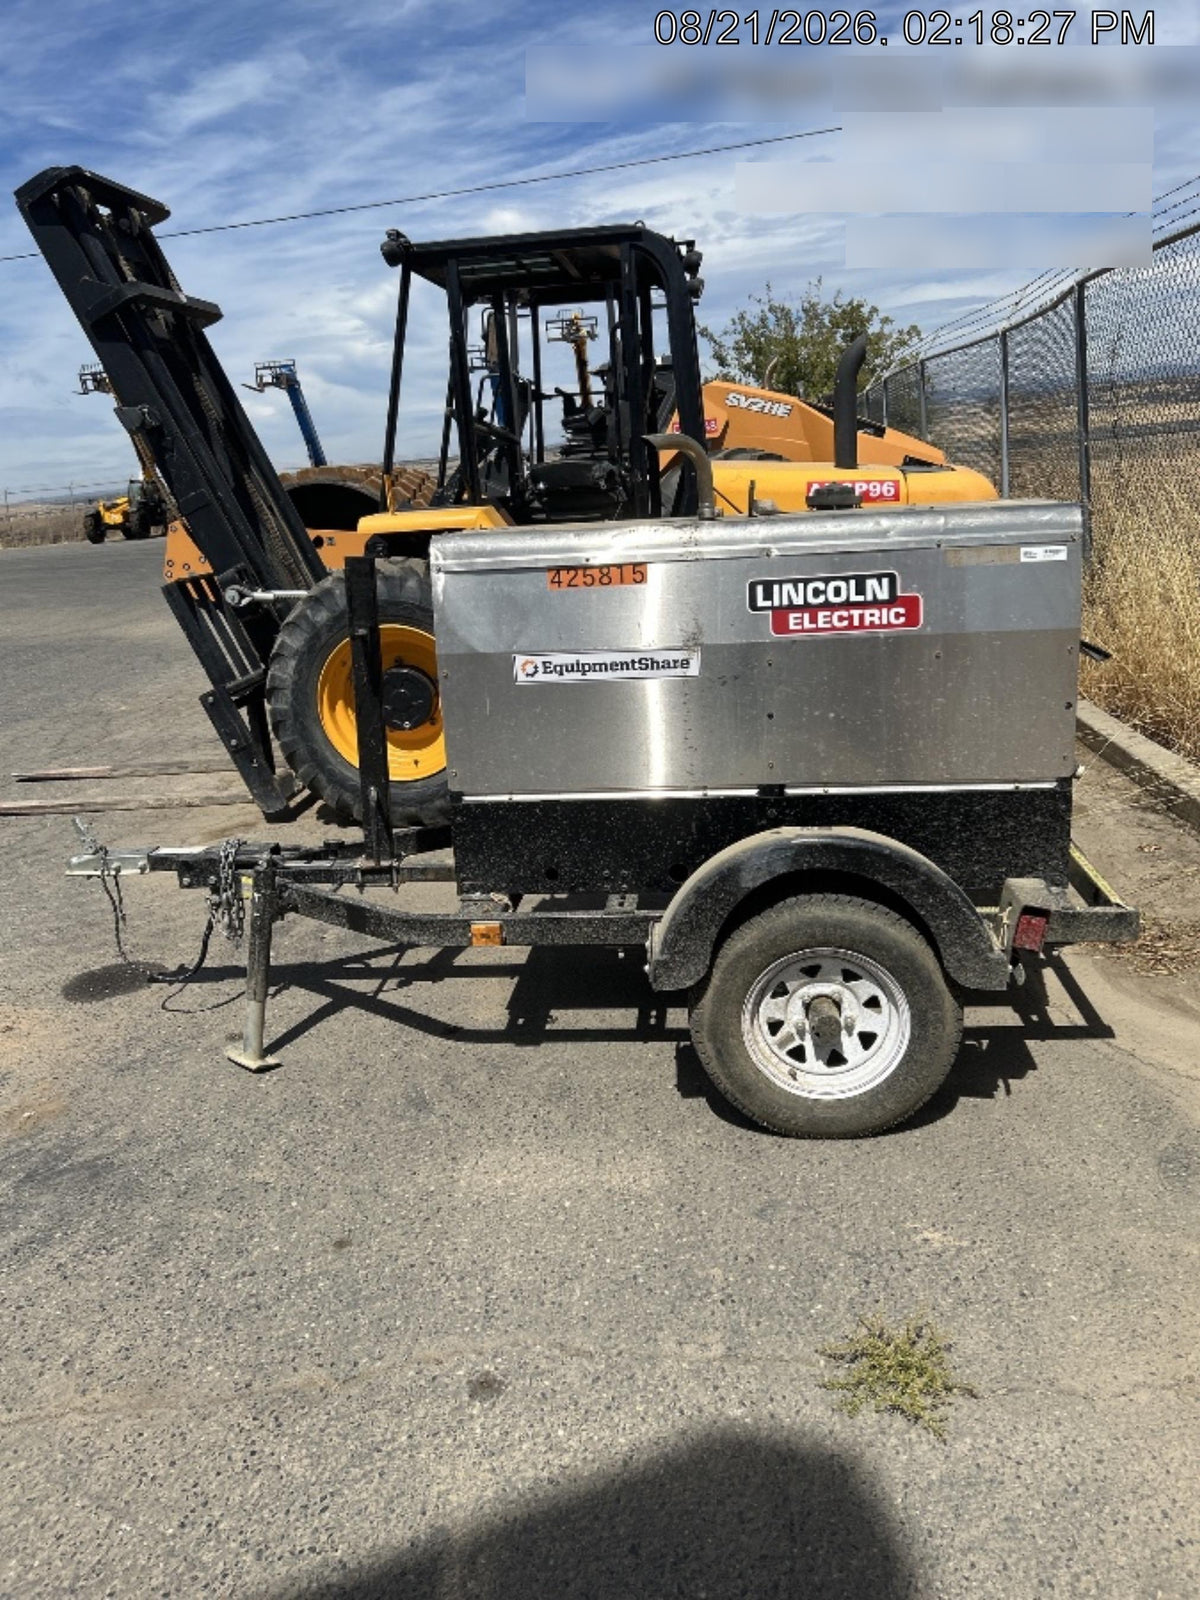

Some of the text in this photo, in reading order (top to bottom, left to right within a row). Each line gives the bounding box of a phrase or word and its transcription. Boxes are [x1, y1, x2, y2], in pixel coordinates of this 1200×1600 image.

[808, 481, 896, 498] AP96
[550, 565, 645, 588] 425815
[755, 576, 890, 607] LINCOLN
[788, 607, 906, 630] ELECTRIC
[541, 656, 690, 676] EquipmentShare
